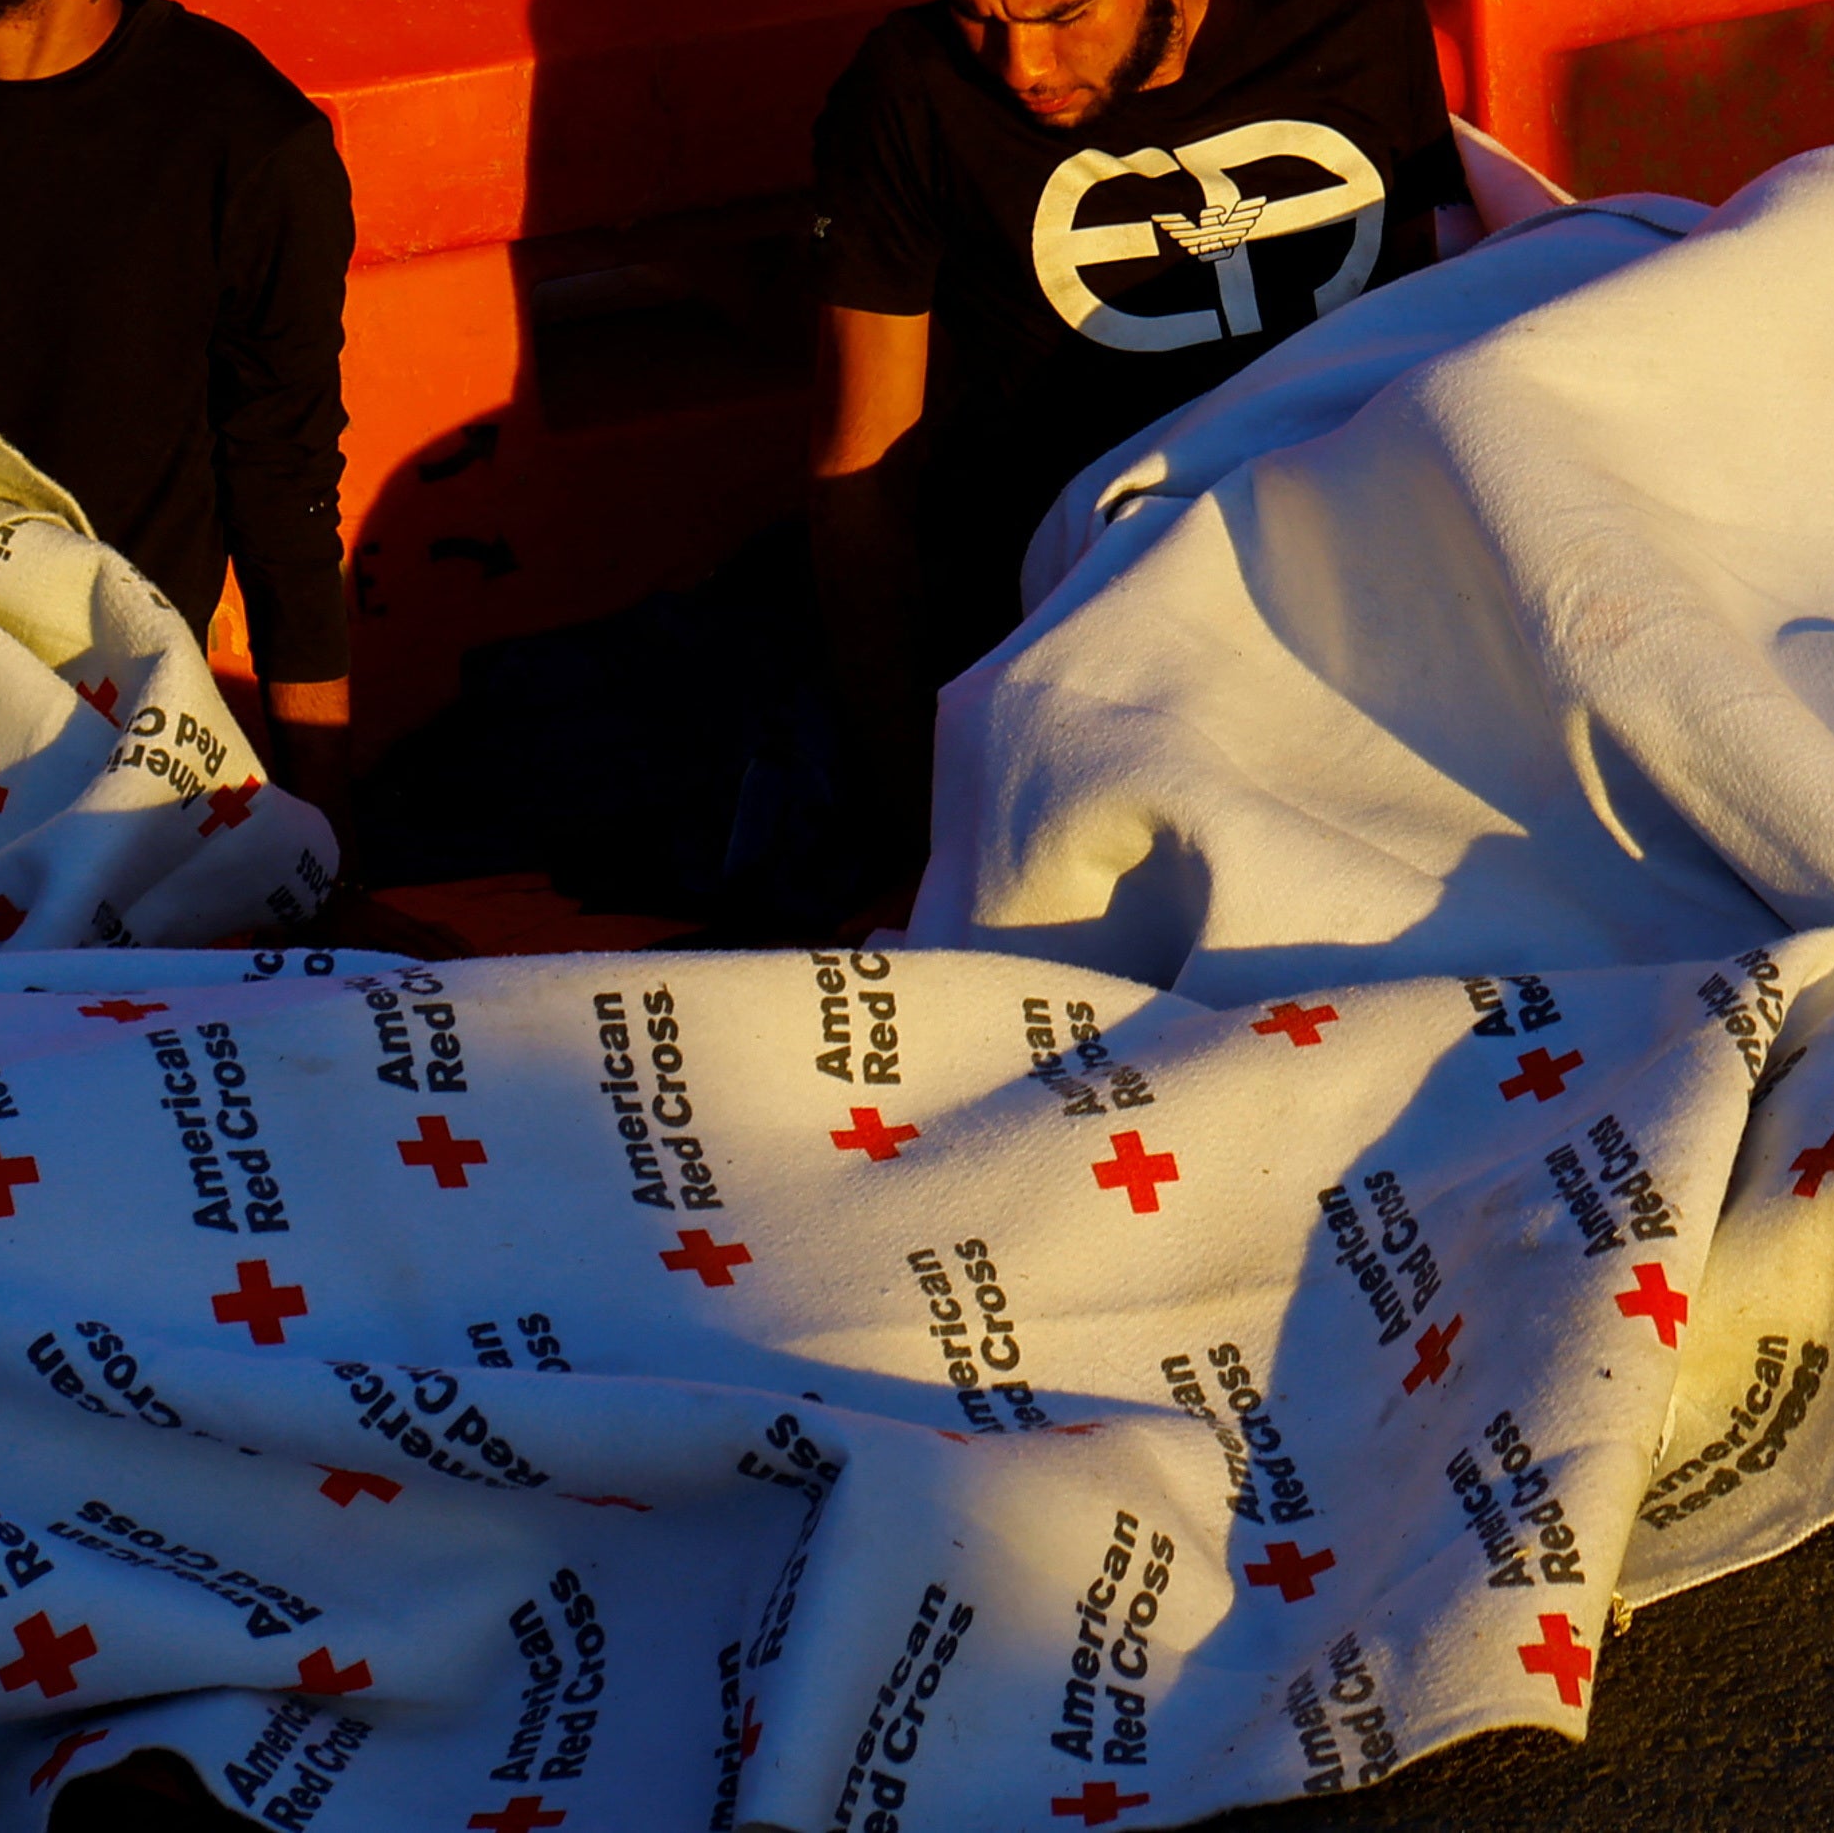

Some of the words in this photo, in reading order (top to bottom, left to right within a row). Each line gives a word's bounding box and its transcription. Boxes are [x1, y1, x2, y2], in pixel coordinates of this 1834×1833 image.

[175, 713, 227, 777] Red
[197, 1022, 259, 1141] Cross
[414, 1003, 467, 1093] Red
[644, 983, 693, 1129] Cross
[863, 992, 901, 1085] Red
[145, 1028, 239, 1234] American
[594, 993, 676, 1210] American
[1586, 1115, 1643, 1186] Cross
[231, 1147, 289, 1234] Red
[662, 1134, 723, 1210] Red
[1364, 1170, 1420, 1257] Cross
[1545, 1143, 1626, 1258] American
[1623, 1174, 1677, 1244] Red
[955, 1238, 1021, 1371] Cross
[1319, 1185, 1411, 1347] American
[1410, 1249, 1442, 1316] Red
[74, 1320, 184, 1430] Cross
[1208, 1342, 1282, 1453] Cross
[445, 1405, 551, 1492] Red
[1258, 1451, 1315, 1525] Red
[1484, 1410, 1552, 1508] Cross
[76, 1500, 218, 1571] Cross
[1447, 1445, 1536, 1590] American
[1526, 1493, 1586, 1586] Red
[217, 1570, 323, 1627] Red
[550, 1568, 606, 1704] Cross
[1051, 1510, 1140, 1764] American
[1110, 1531, 1176, 1679] Cross
[491, 1599, 562, 1783] American
[883, 1602, 975, 1764] Cross
[1104, 1692, 1149, 1766] Red
[264, 1763, 333, 1832] Red
[320, 1717, 373, 1795] Cross
[540, 1694, 598, 1782] Red
